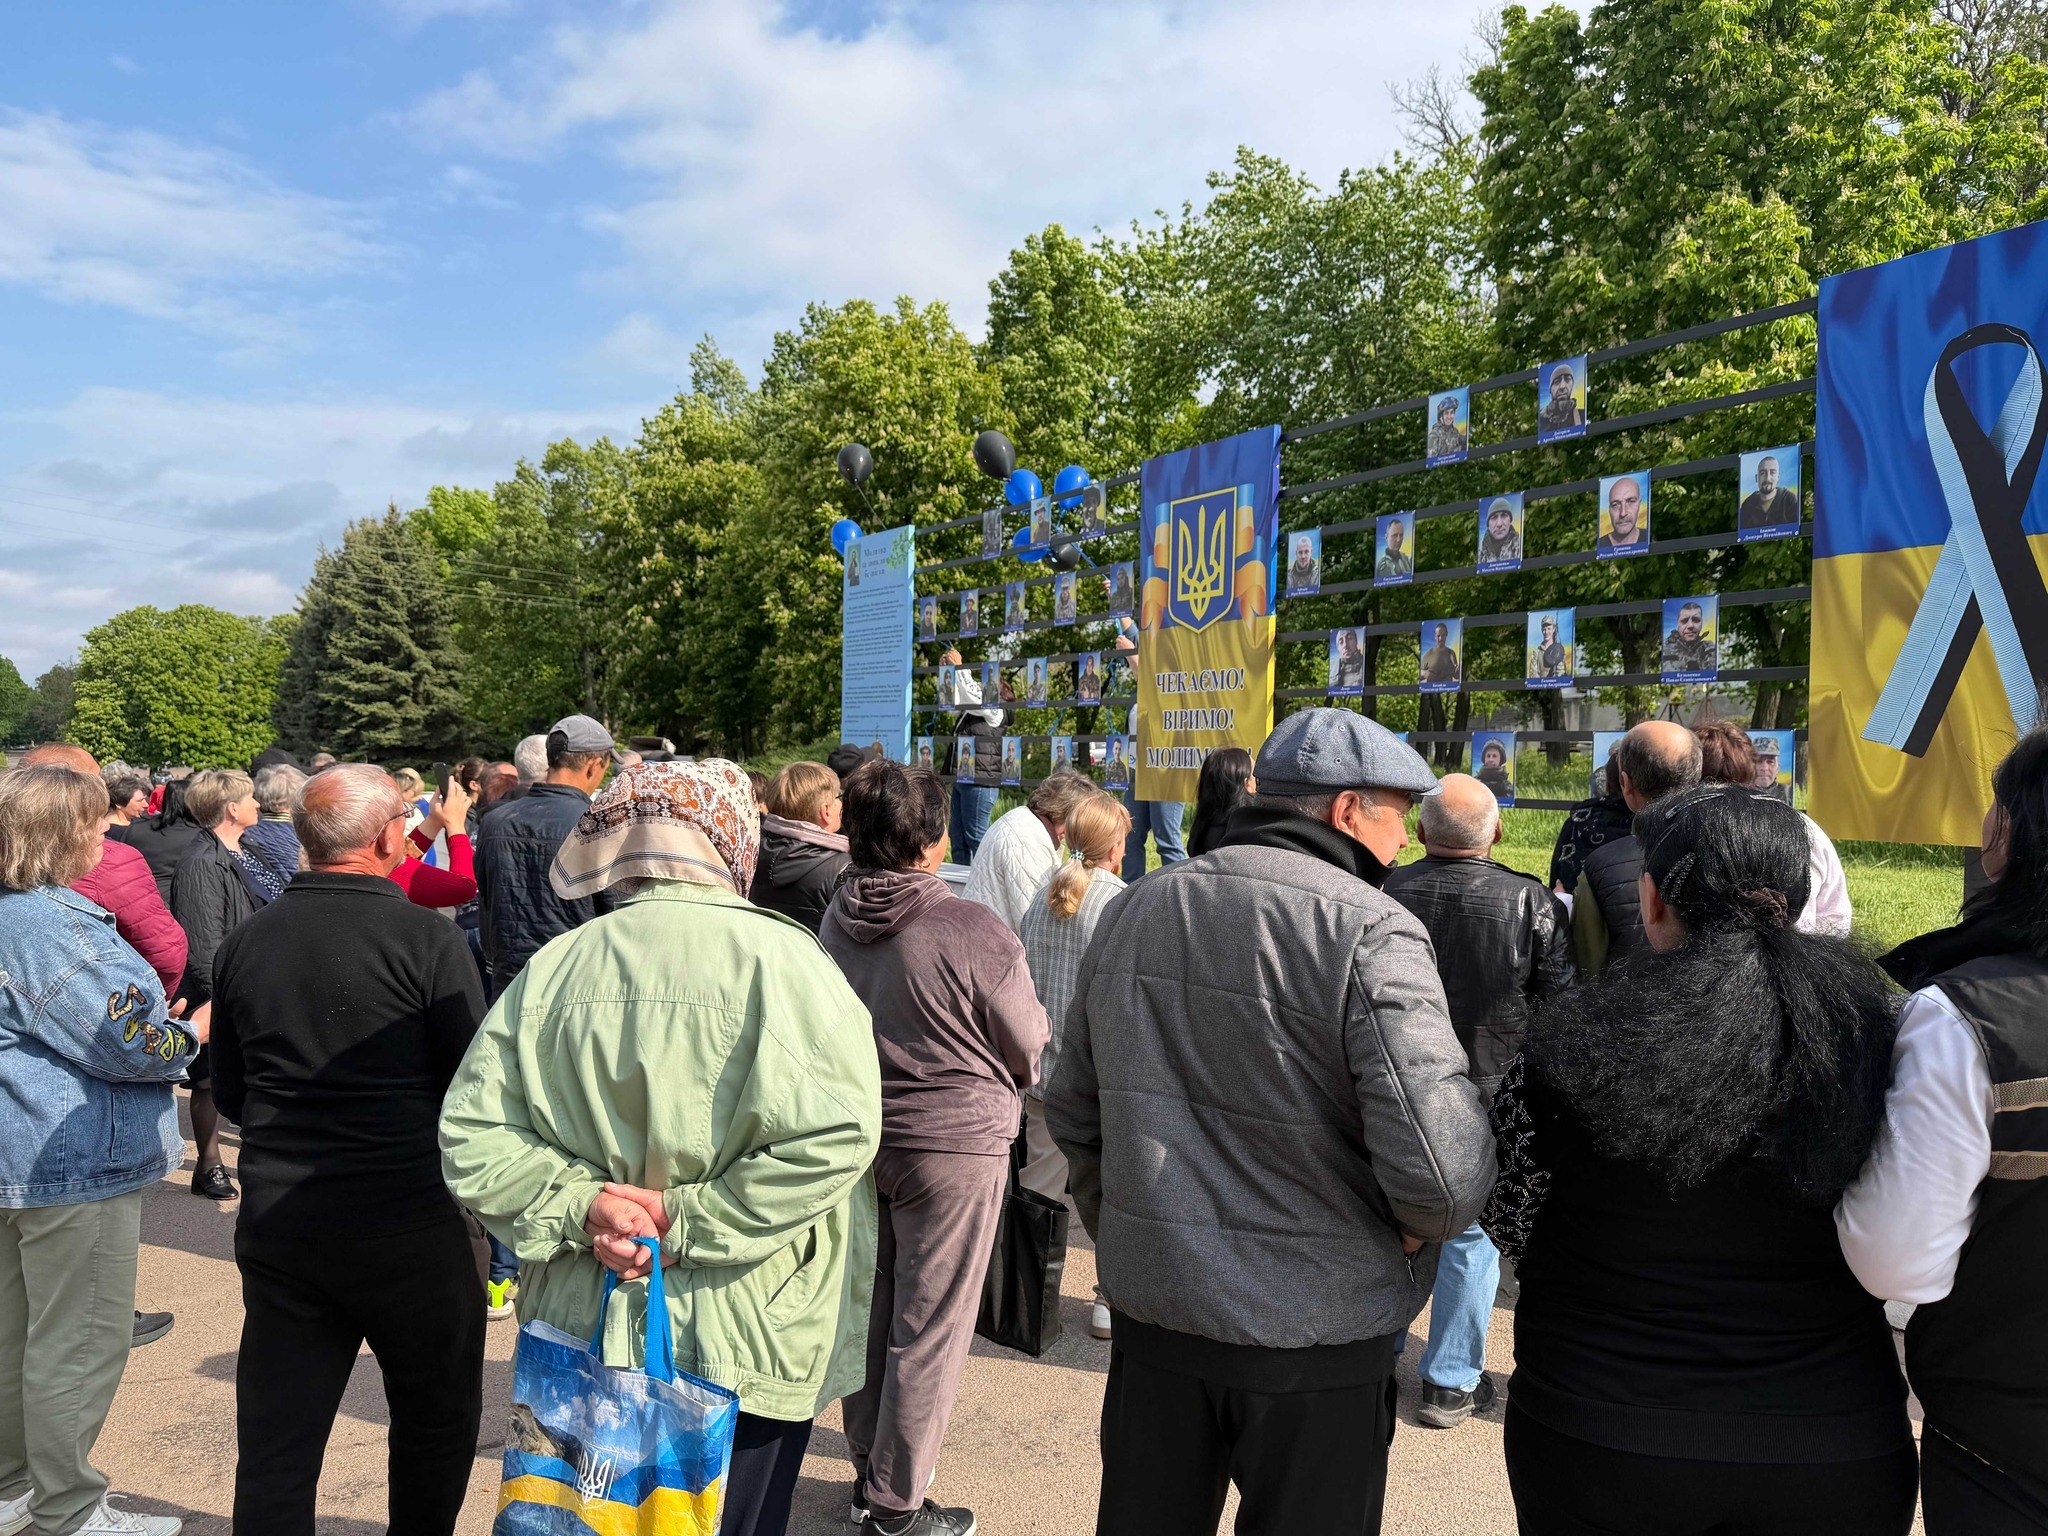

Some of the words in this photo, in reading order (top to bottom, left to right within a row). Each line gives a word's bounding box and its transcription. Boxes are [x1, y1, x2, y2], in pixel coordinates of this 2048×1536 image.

[1156, 668, 1245, 693] ЧЕКАЄМО!
[1163, 708, 1234, 730] ВІРИМО!
[1147, 746, 1252, 768] МОЛИМ
